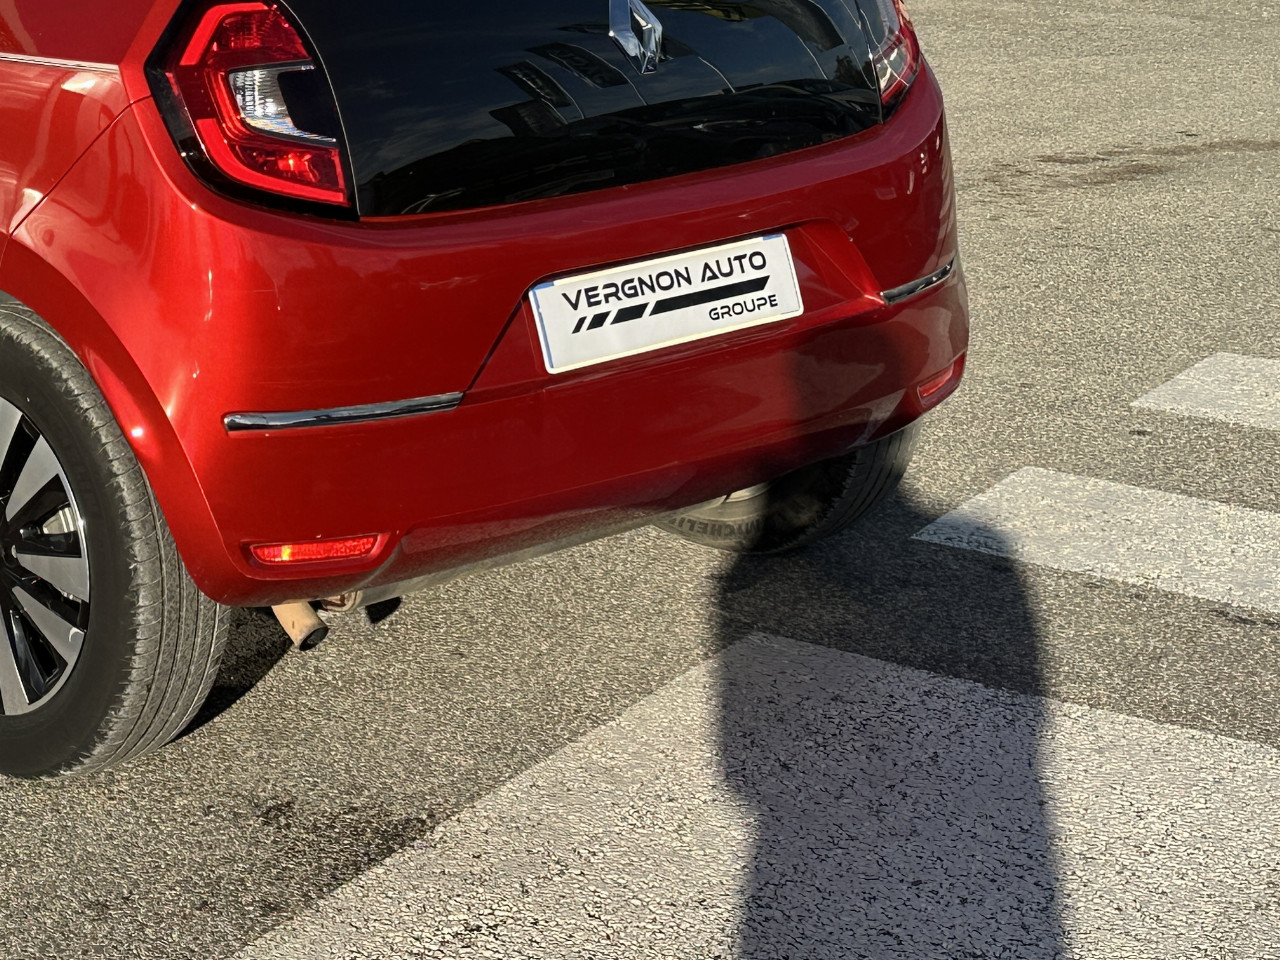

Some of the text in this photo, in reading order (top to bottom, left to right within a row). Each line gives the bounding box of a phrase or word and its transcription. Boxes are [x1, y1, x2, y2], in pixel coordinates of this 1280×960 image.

[562, 251, 767, 310] VERGNON AUTO
[709, 294, 778, 321] GROUPE
